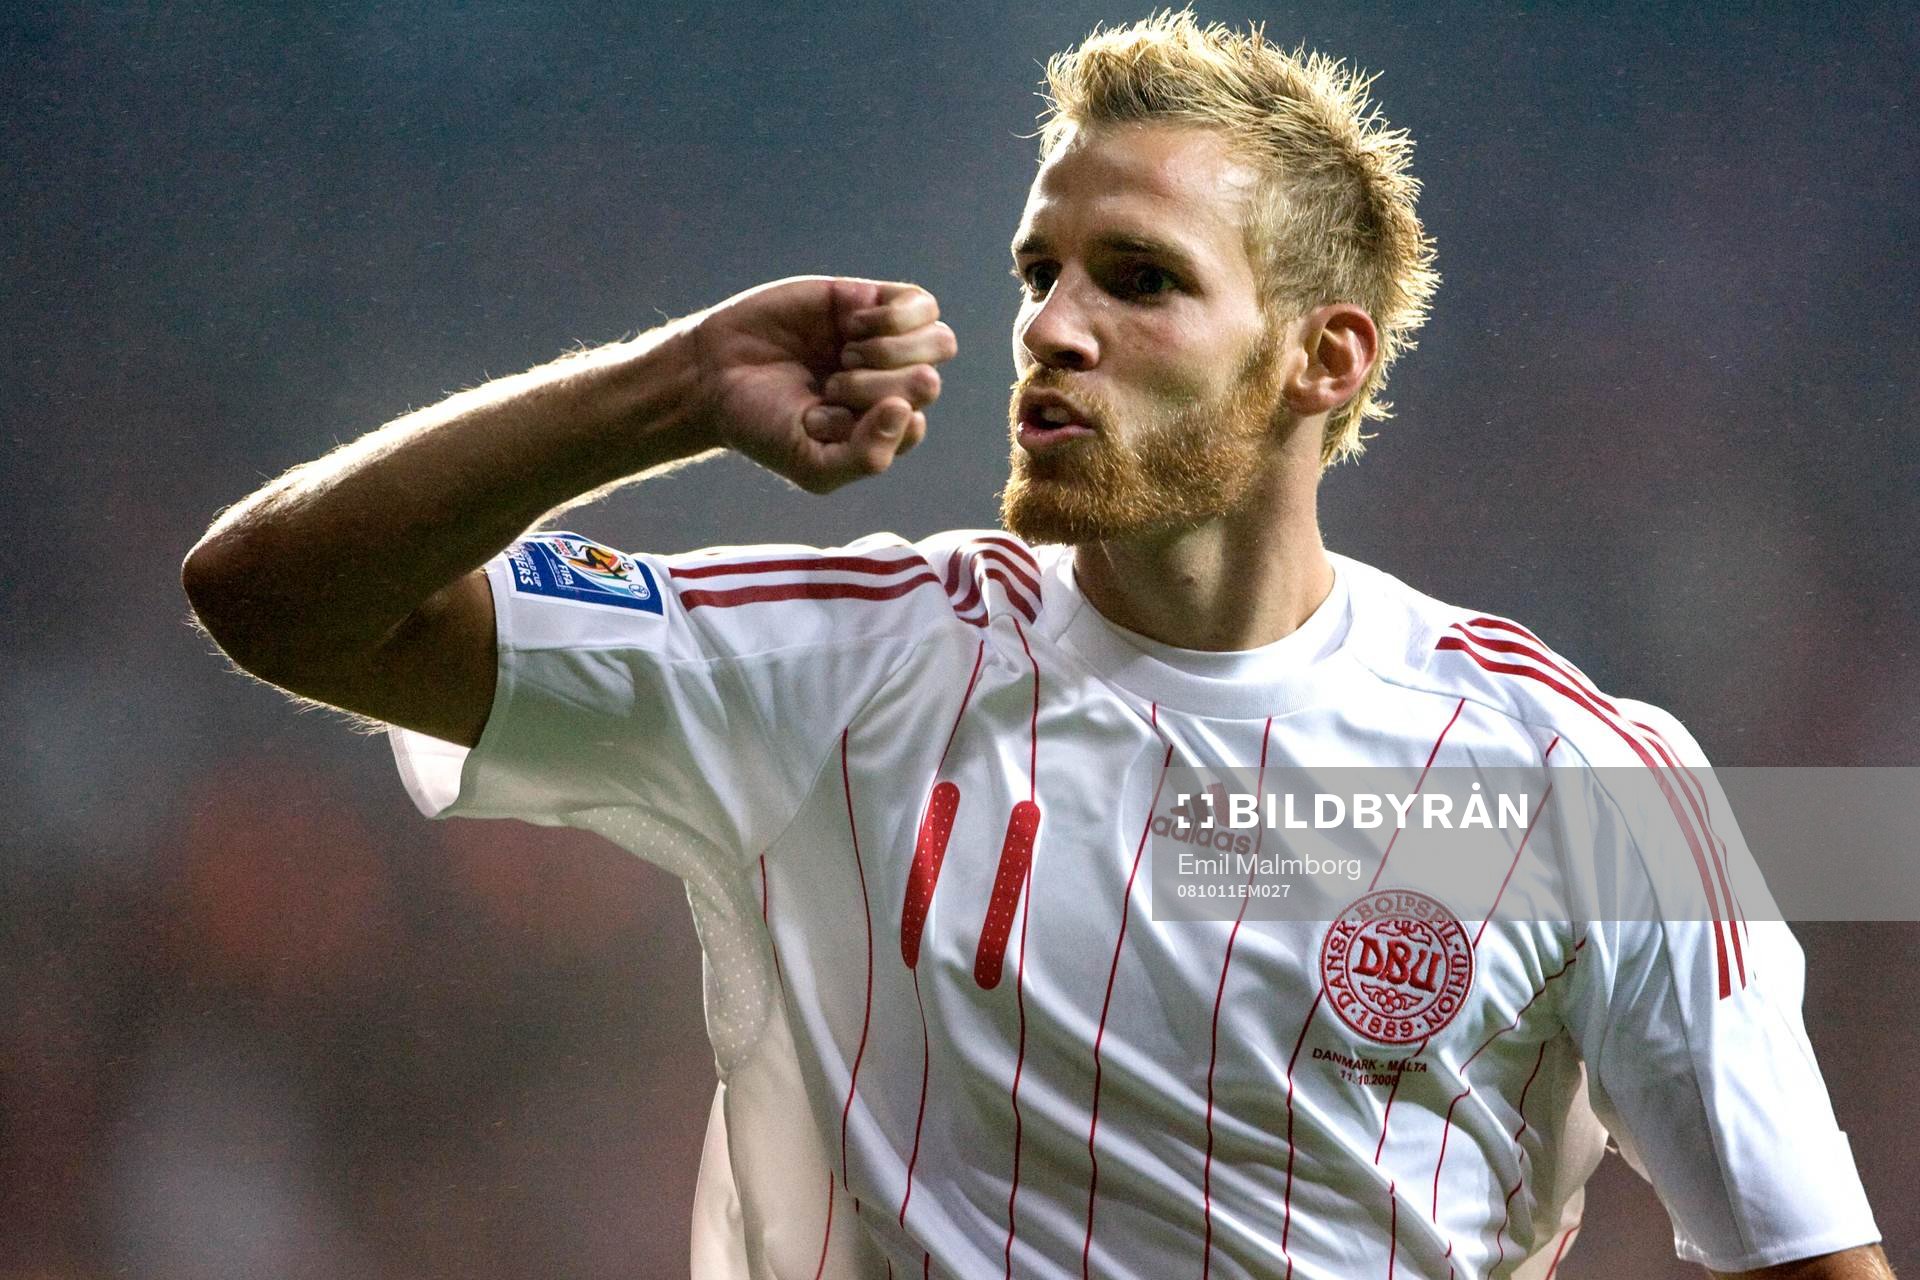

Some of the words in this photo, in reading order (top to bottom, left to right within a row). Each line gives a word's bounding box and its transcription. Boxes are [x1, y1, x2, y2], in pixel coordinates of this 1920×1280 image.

[532, 571, 542, 587] CUP
[558, 564, 574, 585] FIFA
[1151, 815, 1252, 855] adidas
[901, 781, 1041, 990] 11
[1327, 919, 1357, 1010] DANSK
[1352, 935, 1442, 993] DBU
[1356, 1010, 1414, 1037] 1889
[1312, 1048, 1377, 1070] DANMARK
[1387, 1060, 1427, 1072] MALTA
